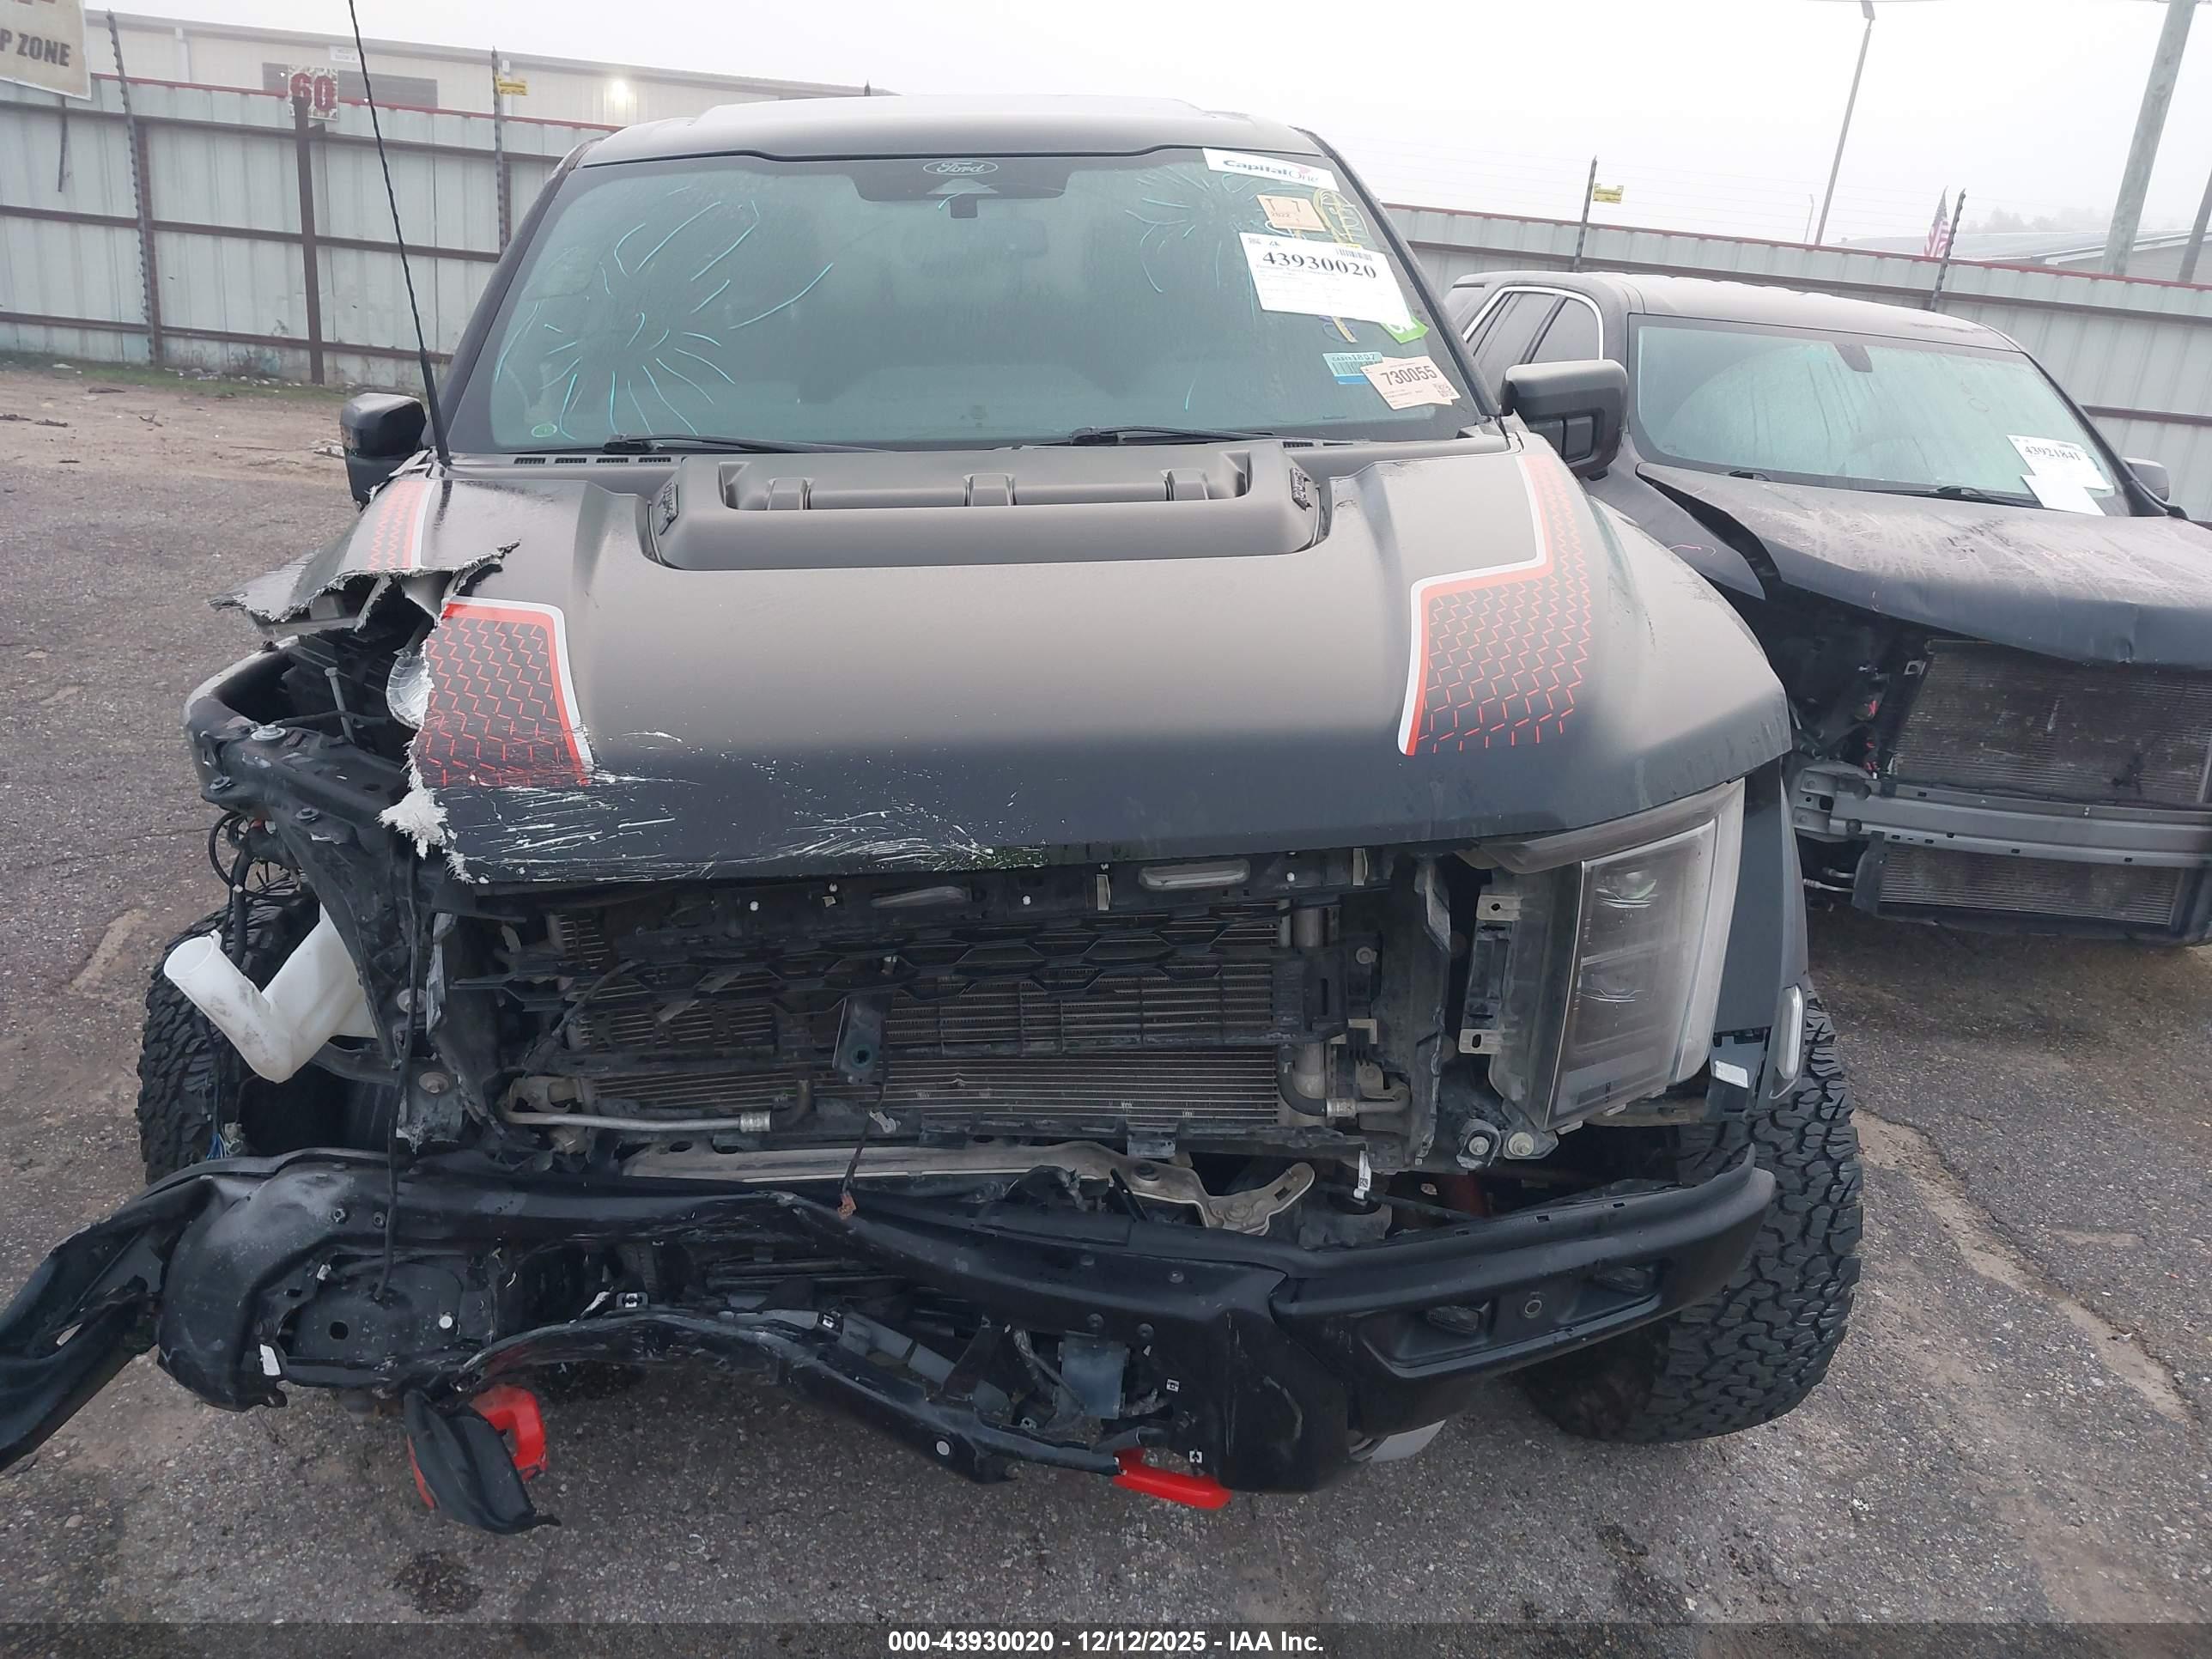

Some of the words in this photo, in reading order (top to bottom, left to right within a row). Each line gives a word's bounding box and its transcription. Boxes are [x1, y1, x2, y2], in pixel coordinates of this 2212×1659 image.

[16, 32, 71, 67] ZONE
[290, 73, 335, 111] 60
[937, 161, 985, 173] Ford
[1262, 251, 1377, 279] 43930020
[1380, 365, 1437, 386] 730055
